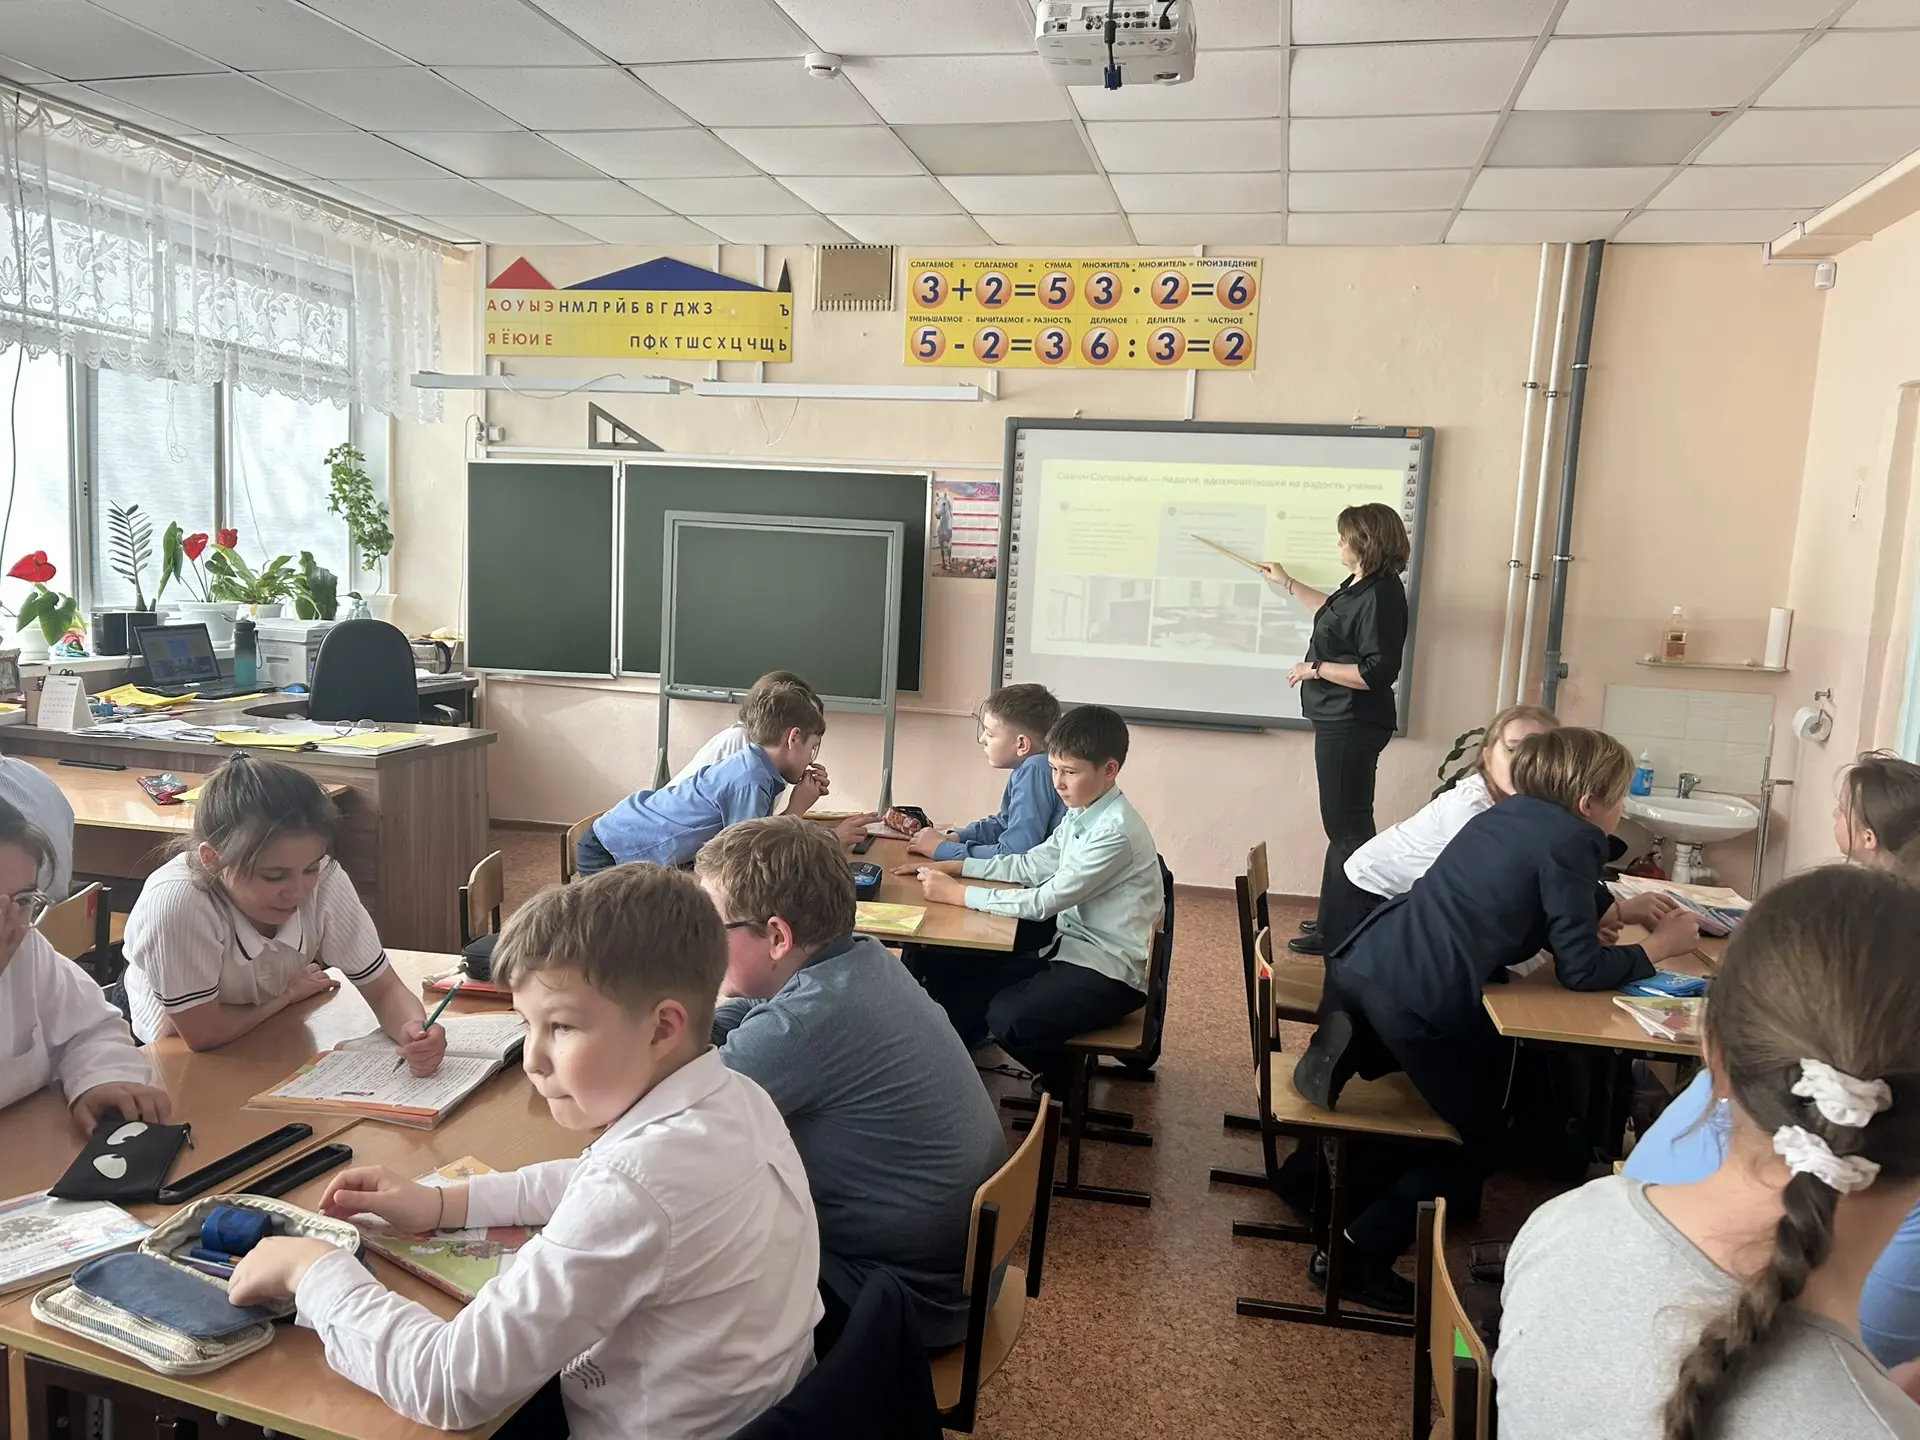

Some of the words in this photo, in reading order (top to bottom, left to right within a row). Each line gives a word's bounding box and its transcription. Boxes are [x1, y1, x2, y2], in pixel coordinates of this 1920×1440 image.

[1196, 260, 1257, 268] ПРОИЗВЕДЕНИЕ
[921, 276, 939, 303] 3
[984, 277, 1002, 304] 2
[1048, 277, 1067, 304] 5
[1094, 277, 1113, 304] 3
[1160, 277, 1179, 304] 2
[1228, 276, 1247, 304] 6
[1090, 317, 1127, 325] ДЕЛИМОЕ
[1146, 317, 1186, 325] ДЕЛИТЕЛЬ
[919, 331, 937, 357] 5
[982, 332, 1000, 358] 2
[1045, 332, 1064, 359] 3
[1091, 332, 1109, 360] 6
[1156, 332, 1175, 360] 3
[1224, 332, 1244, 360] 2
